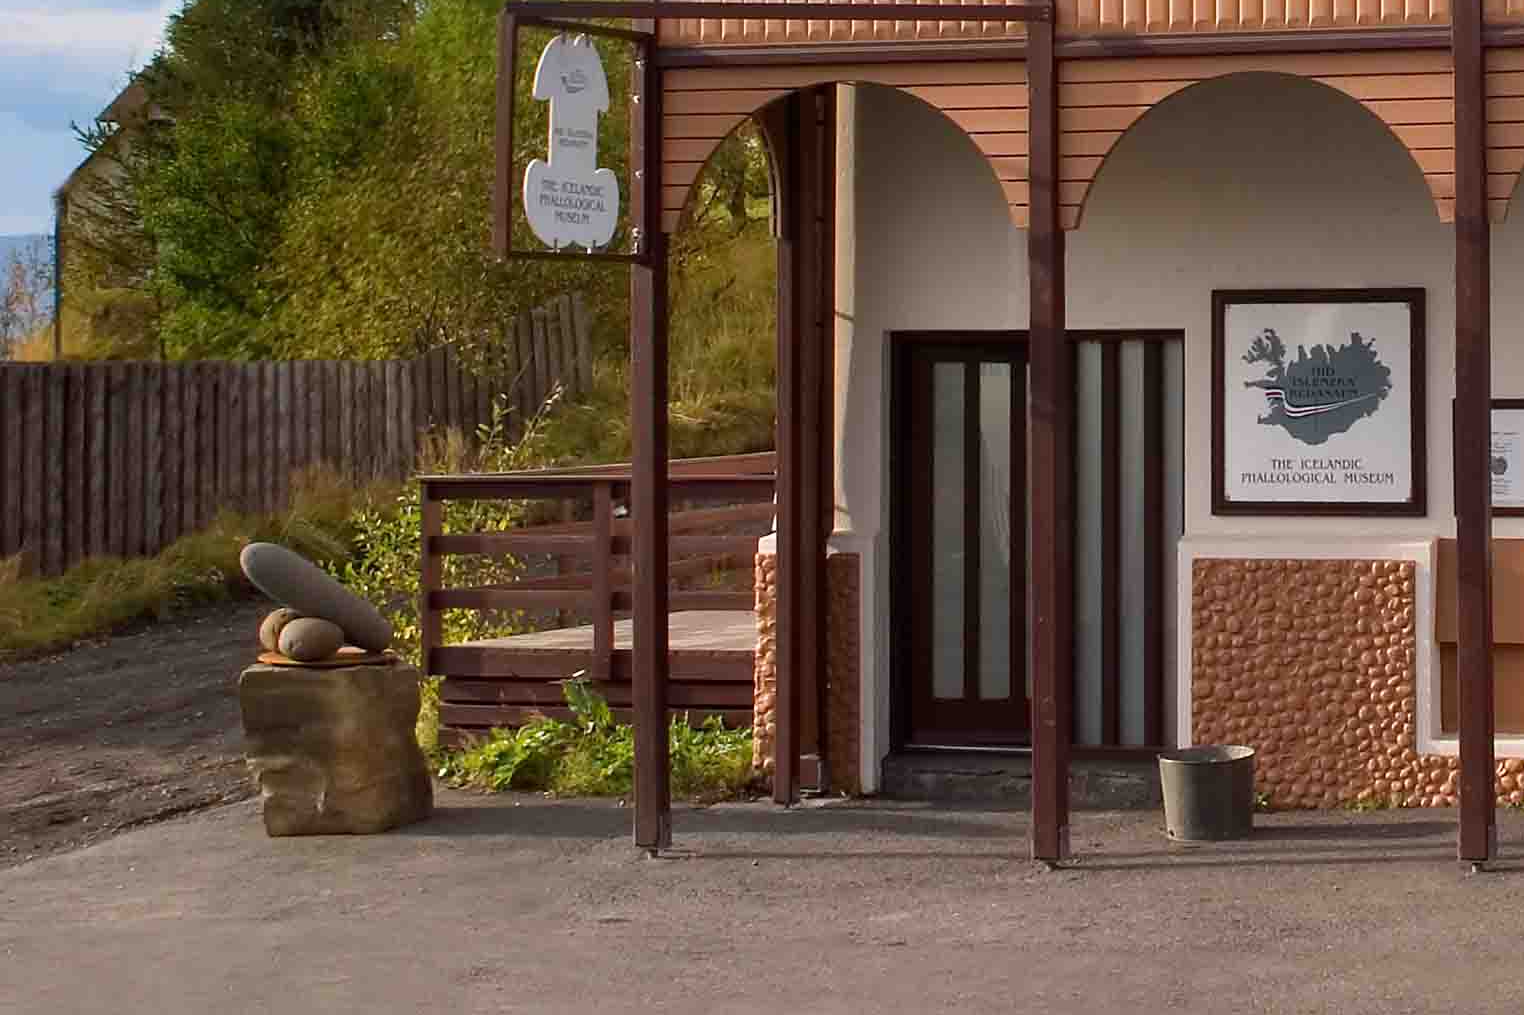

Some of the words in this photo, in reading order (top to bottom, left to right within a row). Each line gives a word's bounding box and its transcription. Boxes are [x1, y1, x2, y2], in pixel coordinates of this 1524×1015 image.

[540, 179, 559, 192] THE
[554, 210, 593, 225] MUSEUM
[1271, 458, 1293, 470] THE
[1300, 458, 1363, 470] ICELANDIC
[1241, 471, 1337, 484] PHALLOLOGICAL
[1343, 471, 1394, 484] MUSEUM
